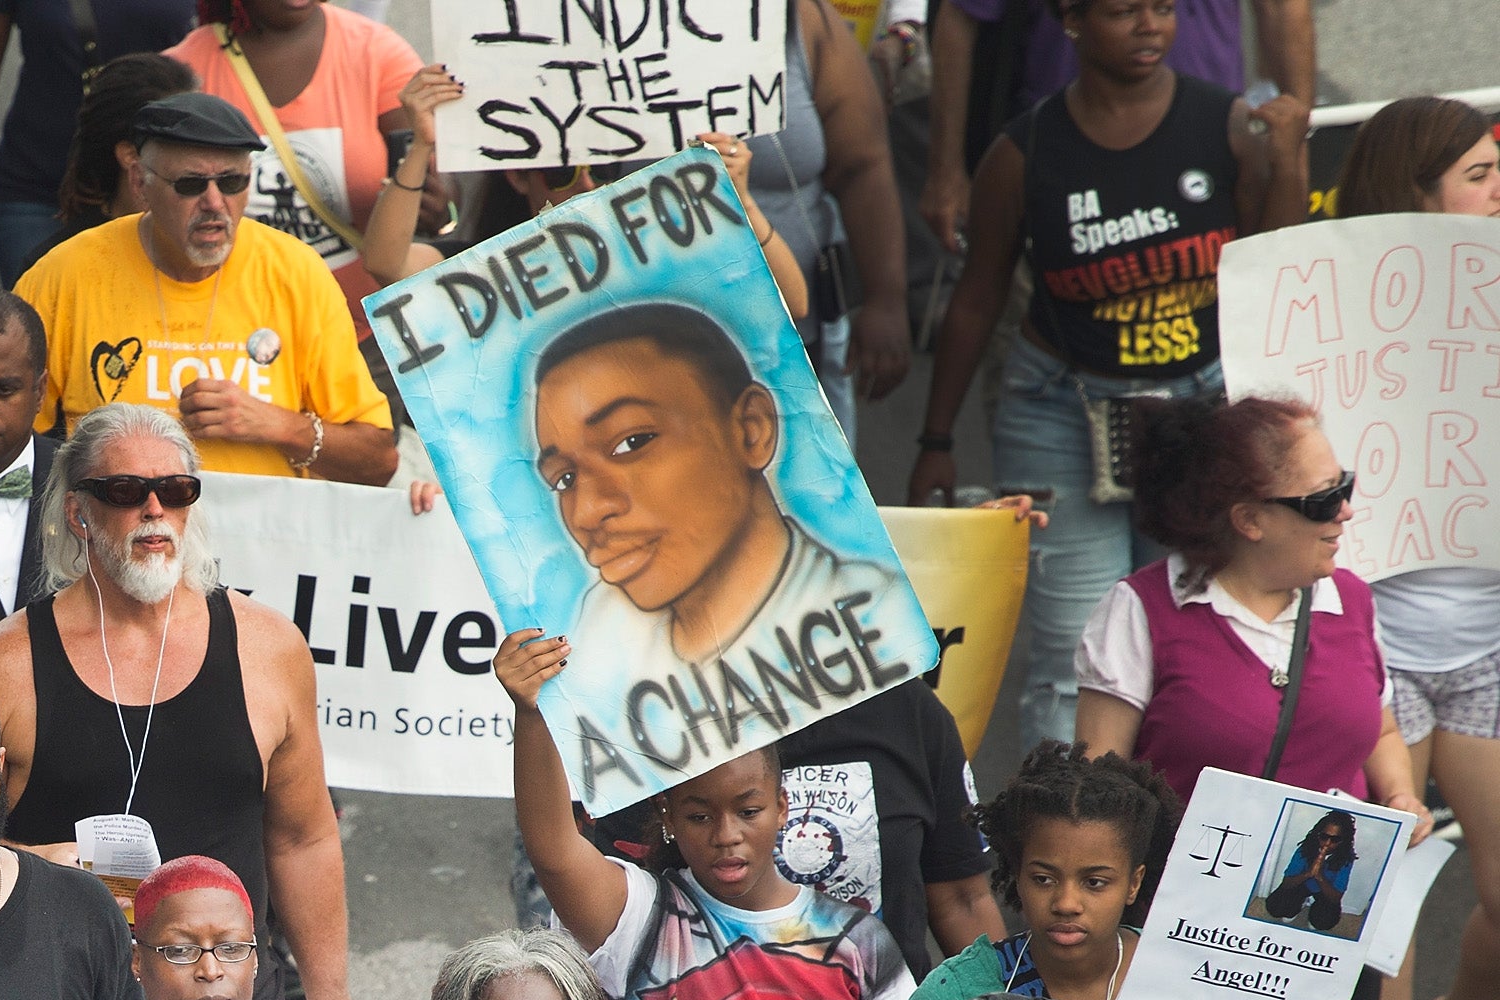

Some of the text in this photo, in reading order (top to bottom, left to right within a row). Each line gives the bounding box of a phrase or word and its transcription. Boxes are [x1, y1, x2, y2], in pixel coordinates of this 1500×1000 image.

[540, 53, 678, 101] THE
[477, 72, 785, 166] SYSTEM
[1067, 189, 1102, 224] BA
[1070, 207, 1179, 254] Speaks:
[372, 162, 743, 374] I DIED FOR
[1043, 226, 1237, 301] REVOLUTIO
[1118, 315, 1200, 365] LESS!
[147, 355, 273, 403] LOVE
[295, 574, 497, 675] Live
[578, 590, 910, 802] A CHANGE
[394, 708, 514, 745] Society
[805, 790, 859, 815] WILSON
[1168, 917, 1339, 970] Justice for our
[1192, 960, 1291, 997] Angel!!!
